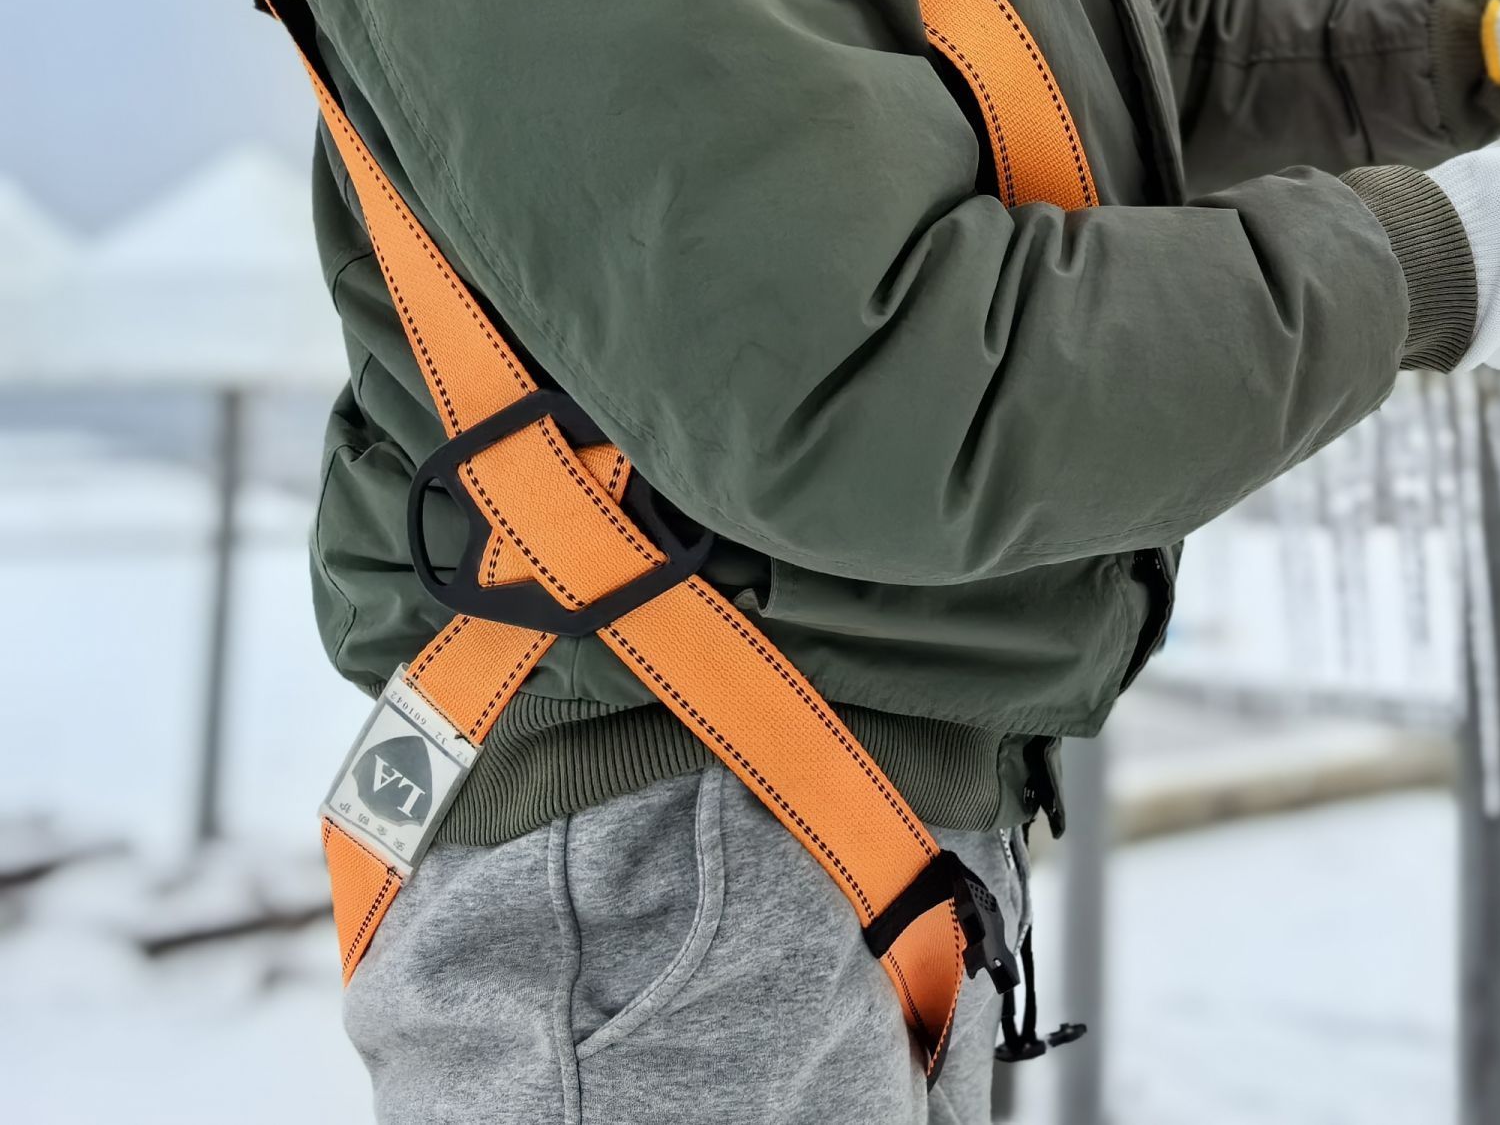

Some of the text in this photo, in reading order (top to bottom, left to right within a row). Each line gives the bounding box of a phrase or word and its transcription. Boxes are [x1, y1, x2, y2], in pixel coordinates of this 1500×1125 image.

[371, 754, 426, 818] LA
[339, 802, 406, 852] 安全防护
